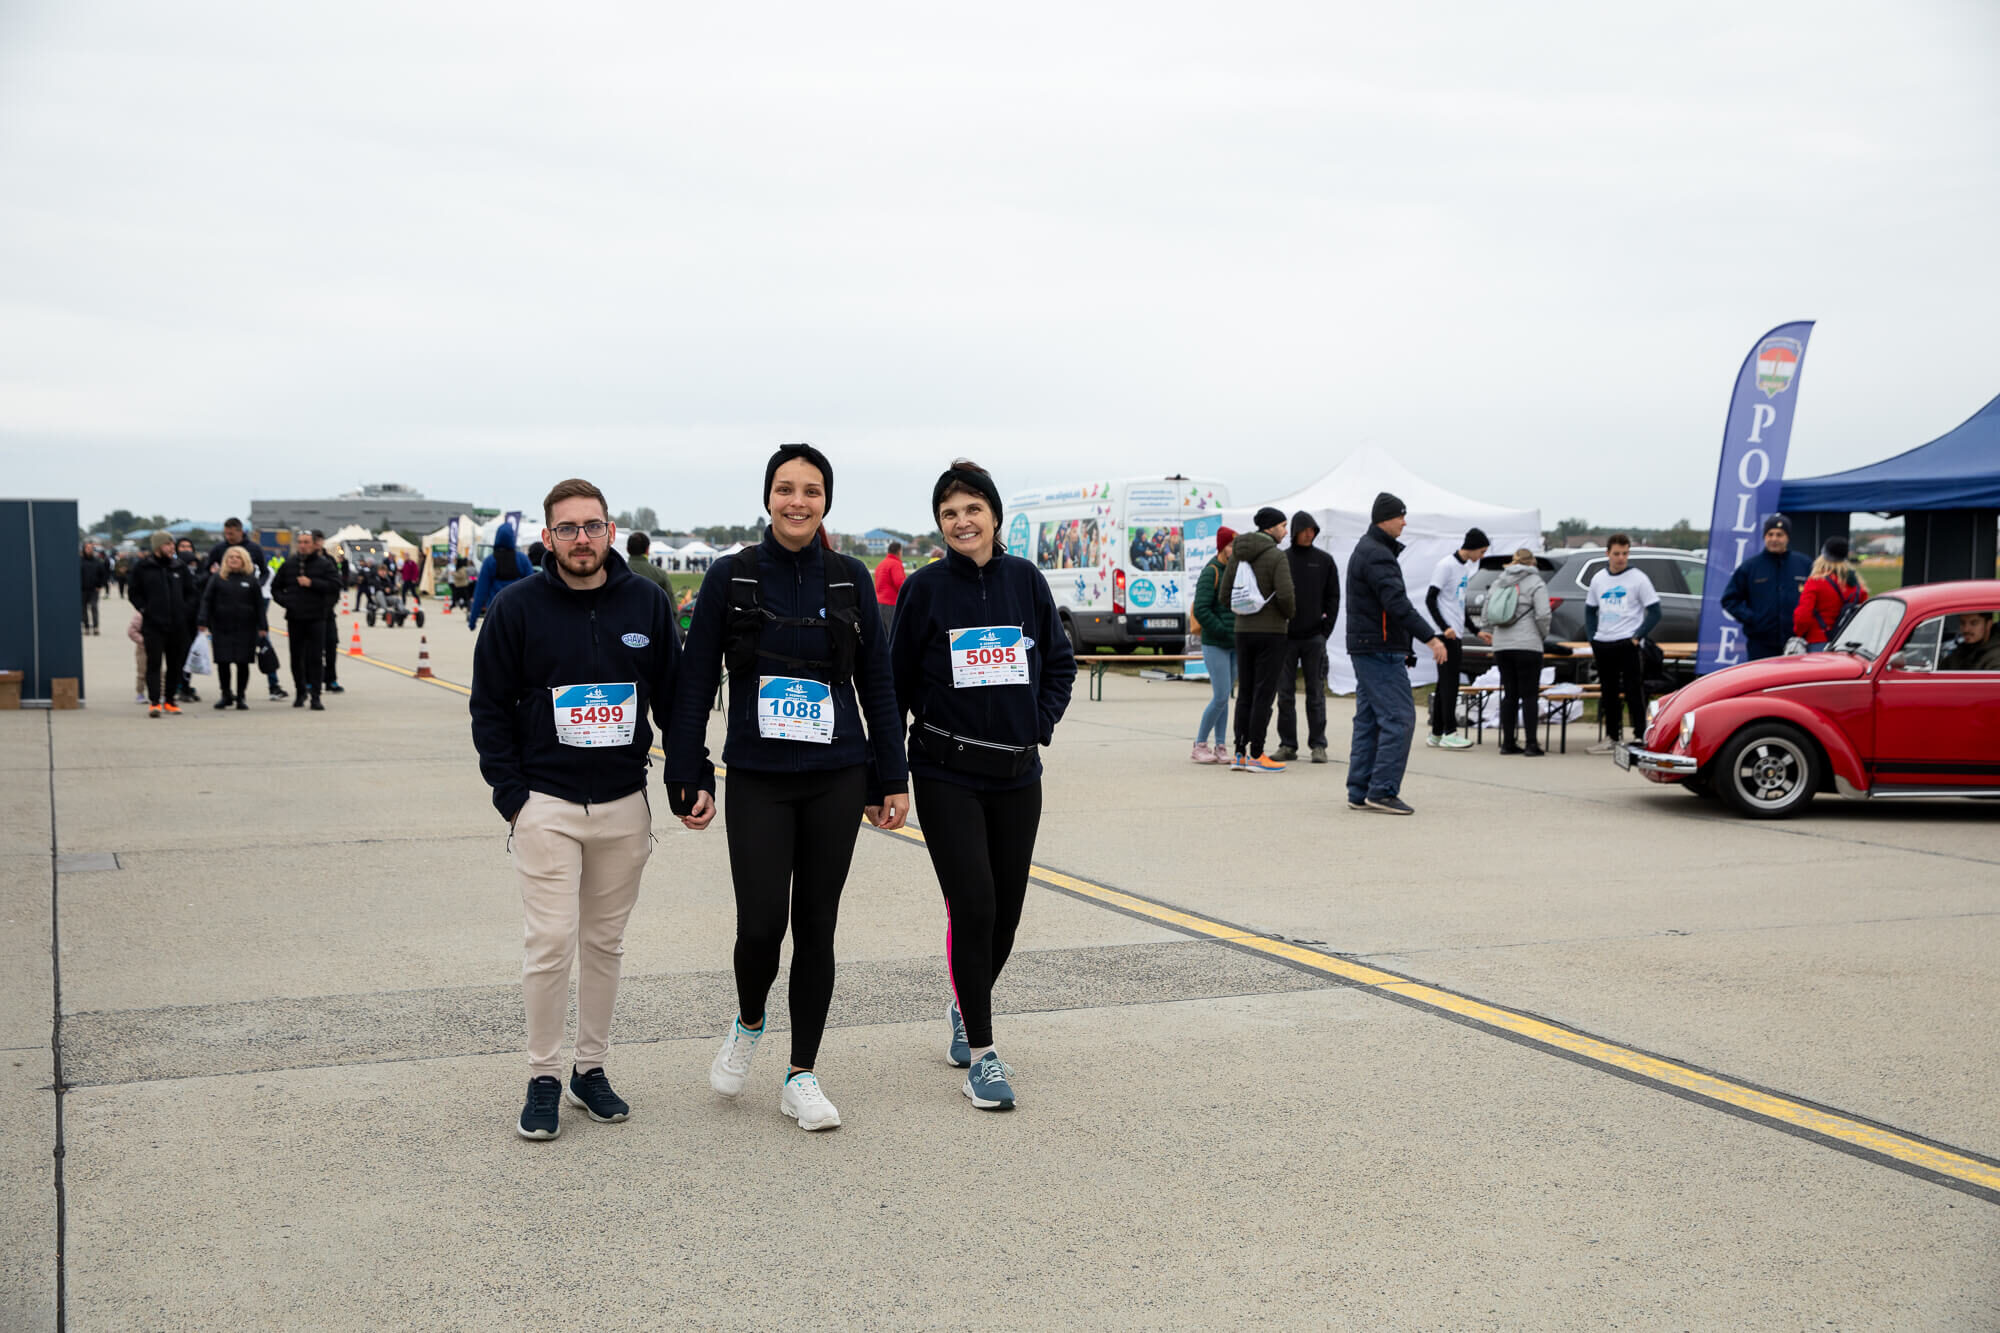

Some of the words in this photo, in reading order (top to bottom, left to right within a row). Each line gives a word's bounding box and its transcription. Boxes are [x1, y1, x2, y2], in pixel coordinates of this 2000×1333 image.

[1714, 404, 1776, 665] POLIE
[966, 648, 1016, 665] 5095
[570, 706, 624, 724] 5499
[769, 699, 821, 719] 1088
